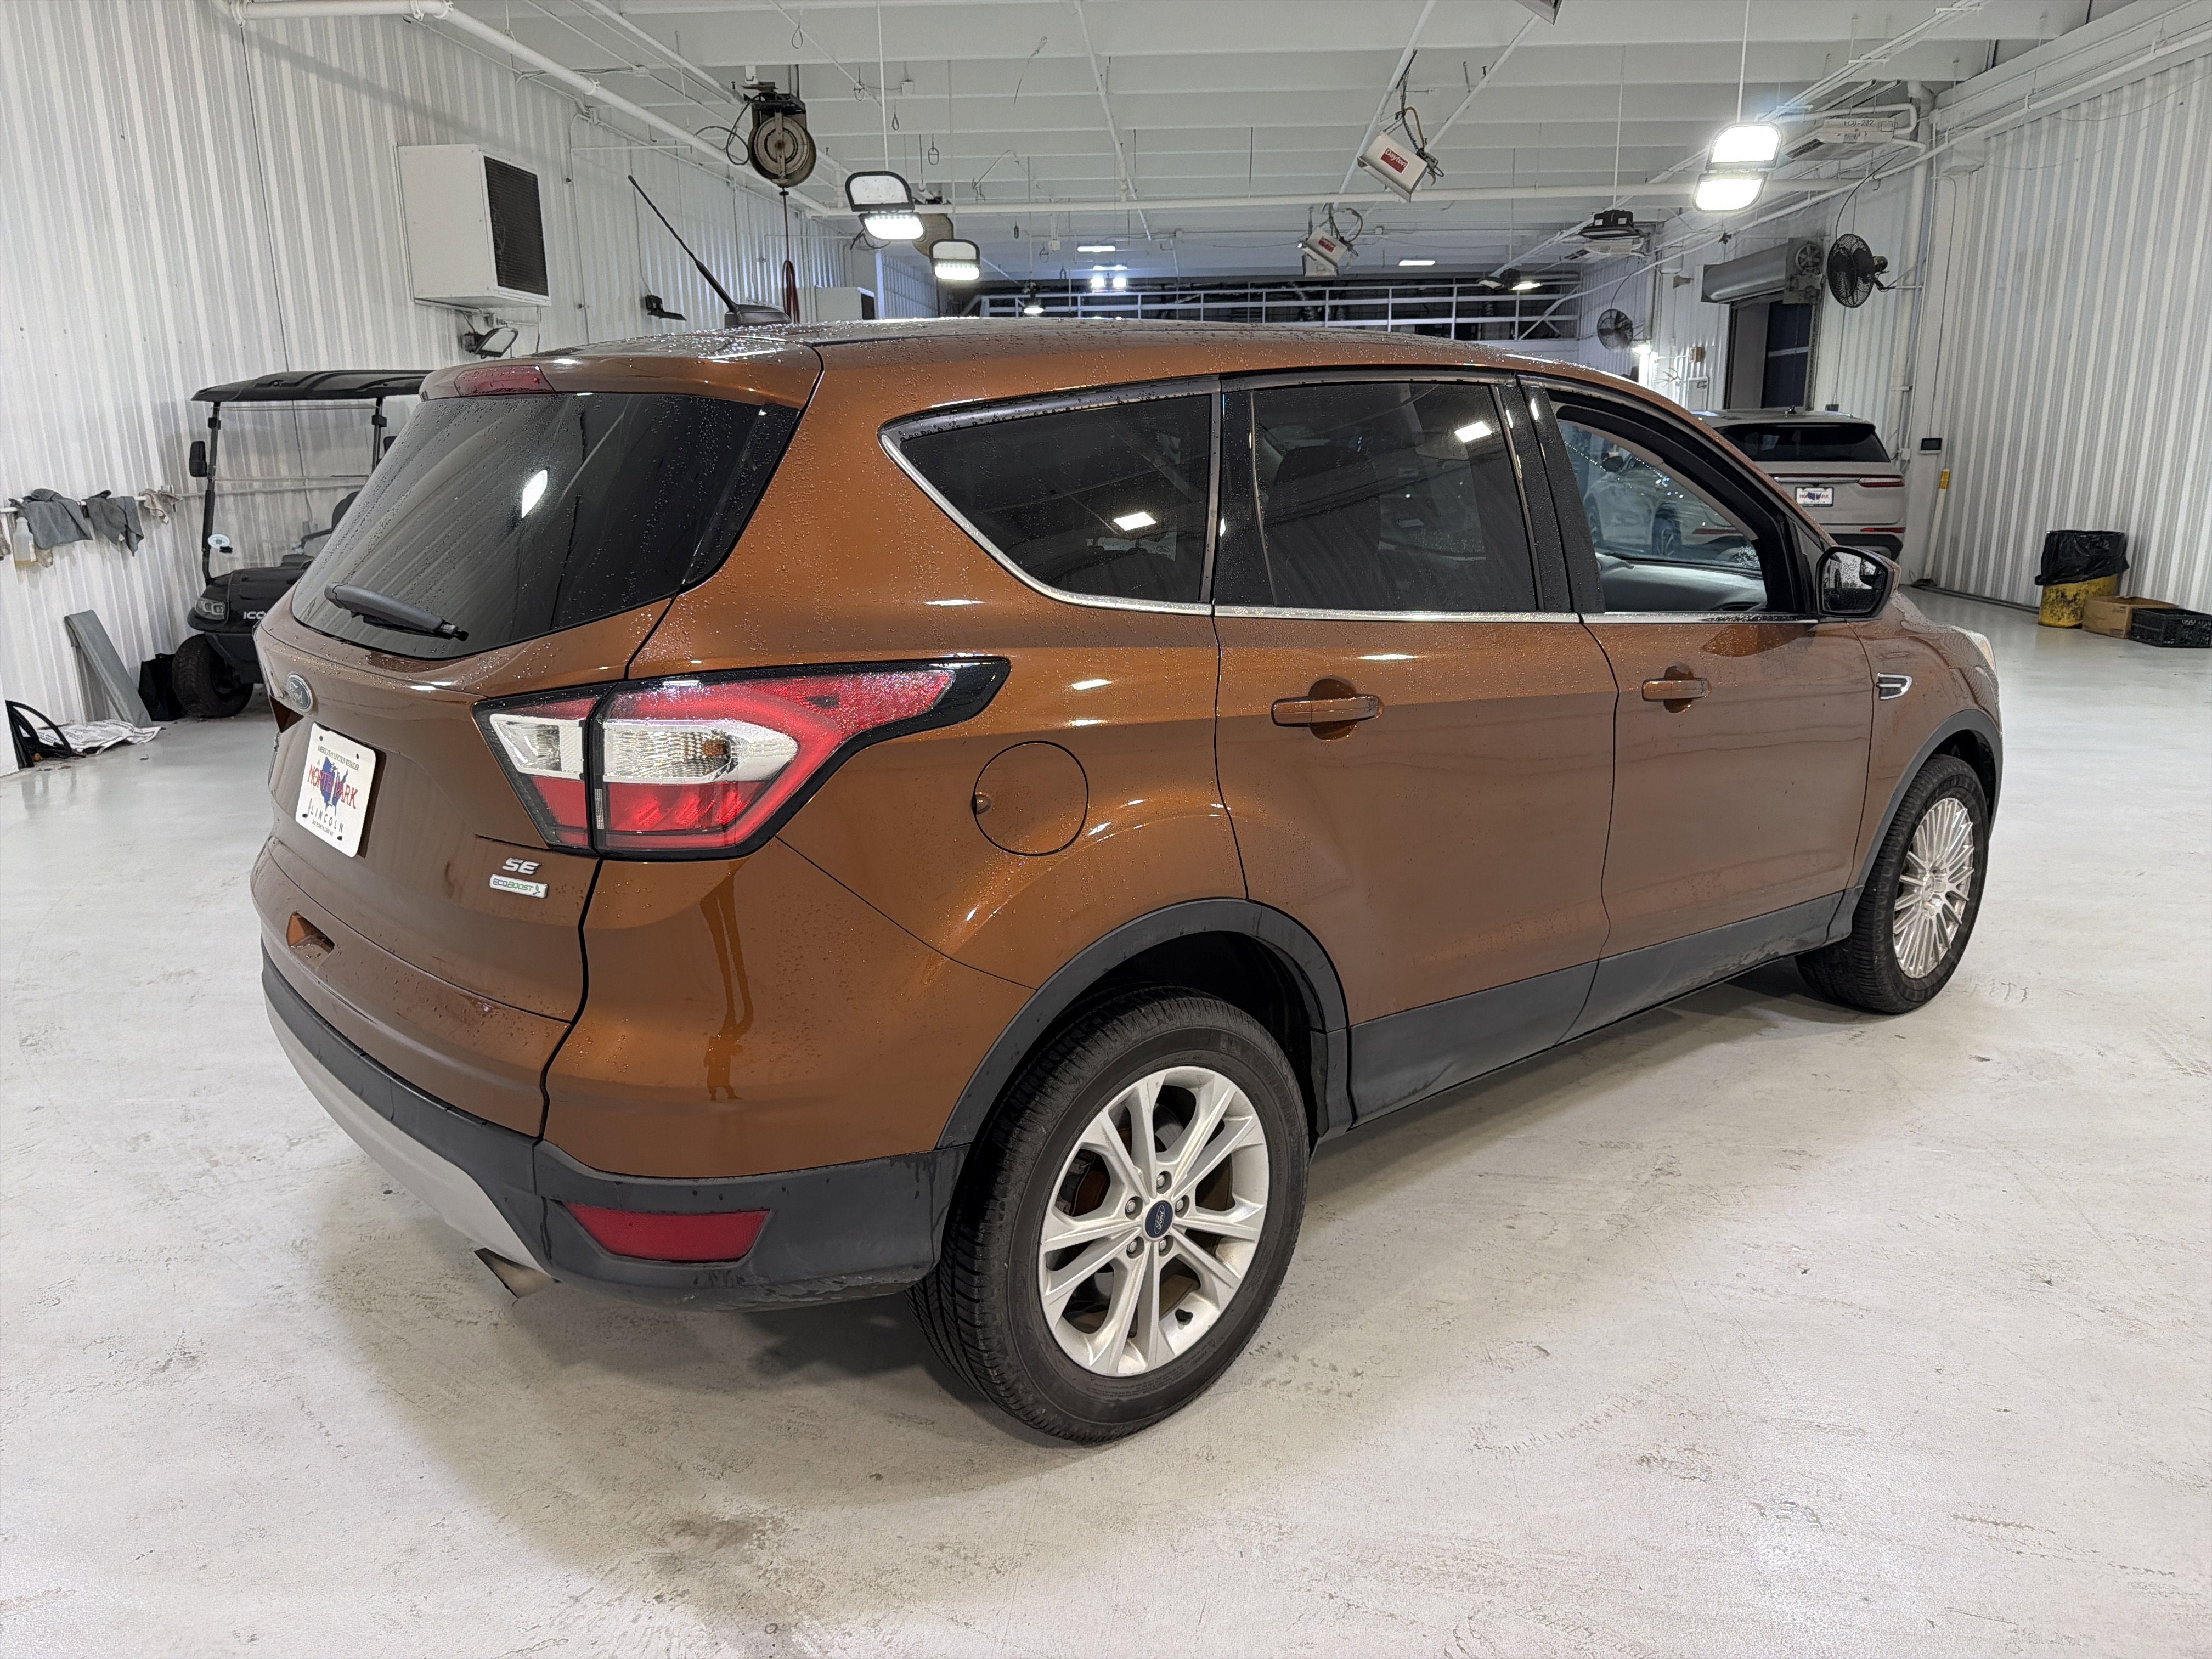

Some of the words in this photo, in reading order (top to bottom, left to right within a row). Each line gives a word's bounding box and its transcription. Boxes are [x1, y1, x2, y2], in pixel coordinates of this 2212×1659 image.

[1385, 149, 1407, 167] Dayton
[289, 681, 303, 704] Ford
[308, 764, 334, 794] NORTH
[335, 774, 358, 809] PARK
[311, 805, 344, 833] LINCOLN
[501, 857, 542, 875] SE
[493, 878, 534, 891] ECOBOOST
[1155, 1210, 1164, 1230] Ford
